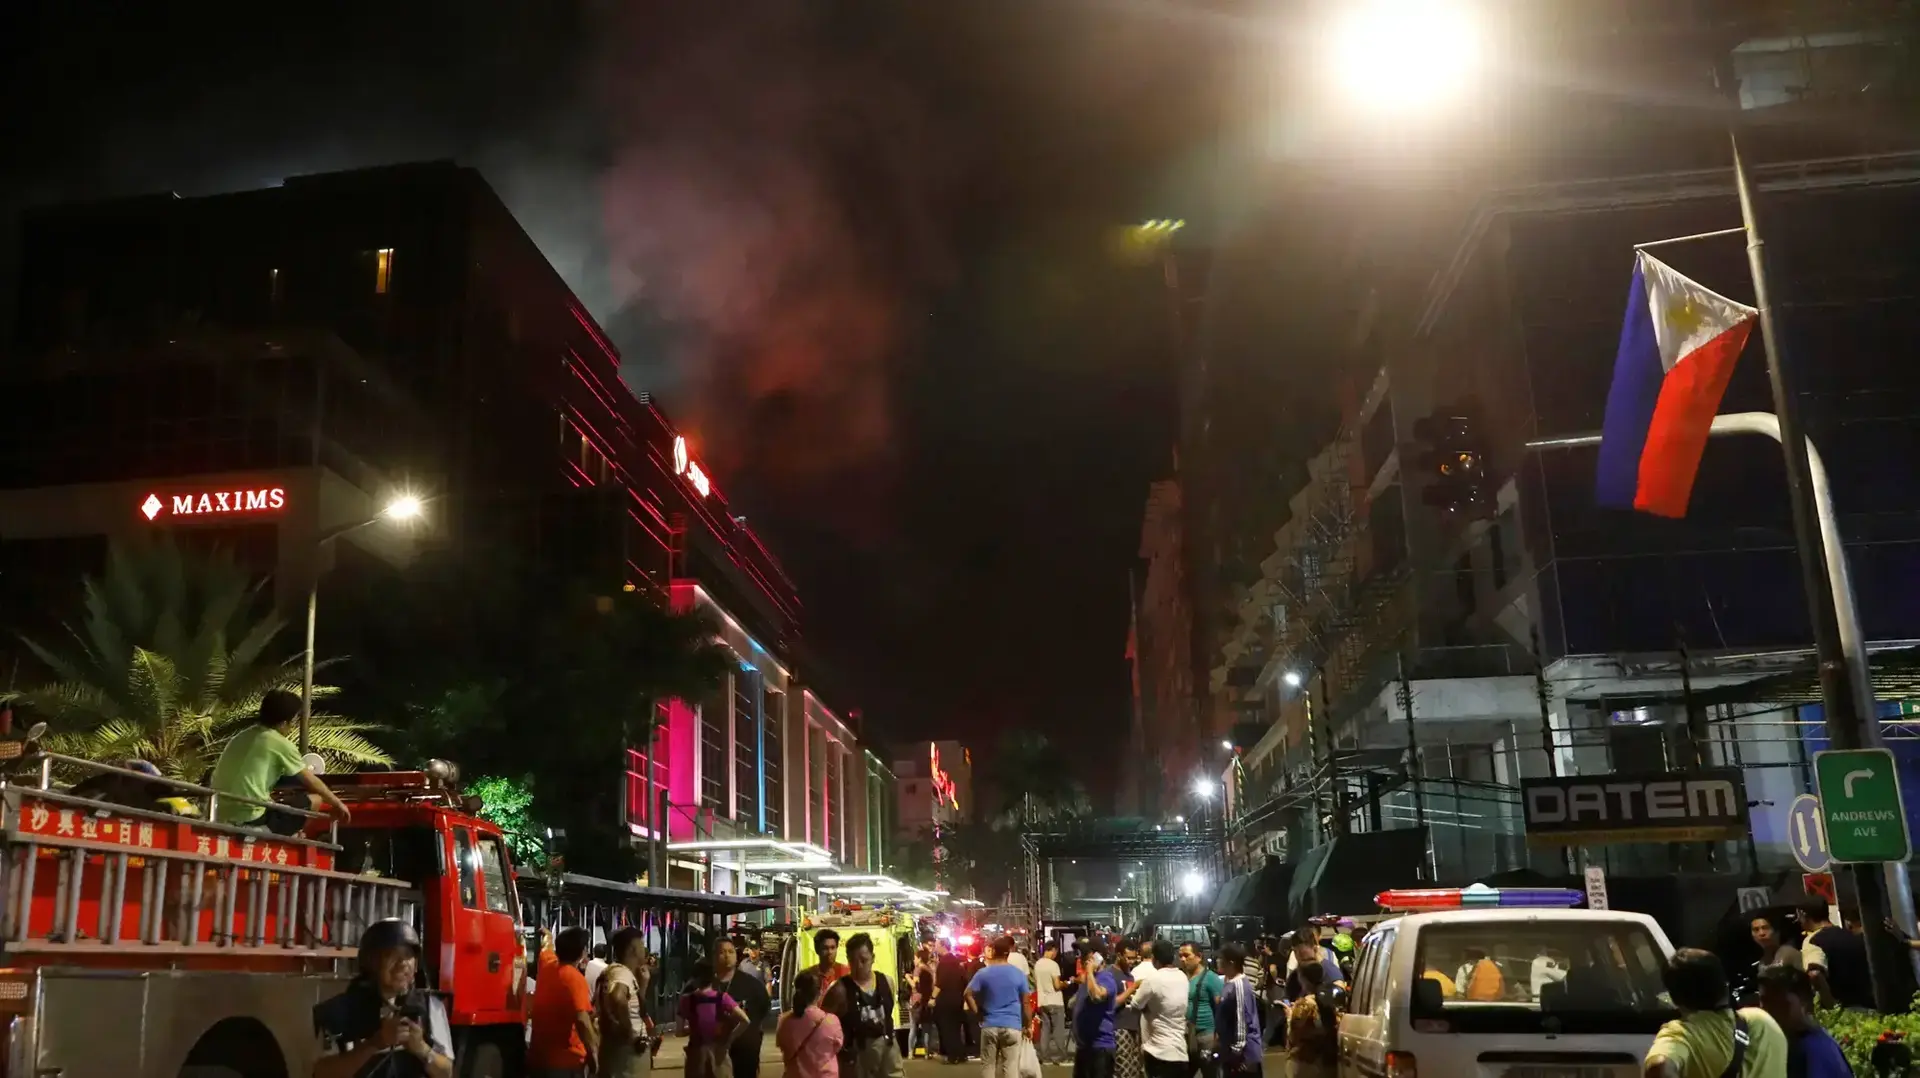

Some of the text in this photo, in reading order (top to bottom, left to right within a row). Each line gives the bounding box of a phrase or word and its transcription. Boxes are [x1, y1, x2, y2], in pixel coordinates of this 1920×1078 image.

[172, 488, 285, 515] MAXIMS
[1526, 780, 1737, 823] DATEM
[1831, 810, 1895, 822] ANDREWS
[1853, 826, 1879, 837] AVE
